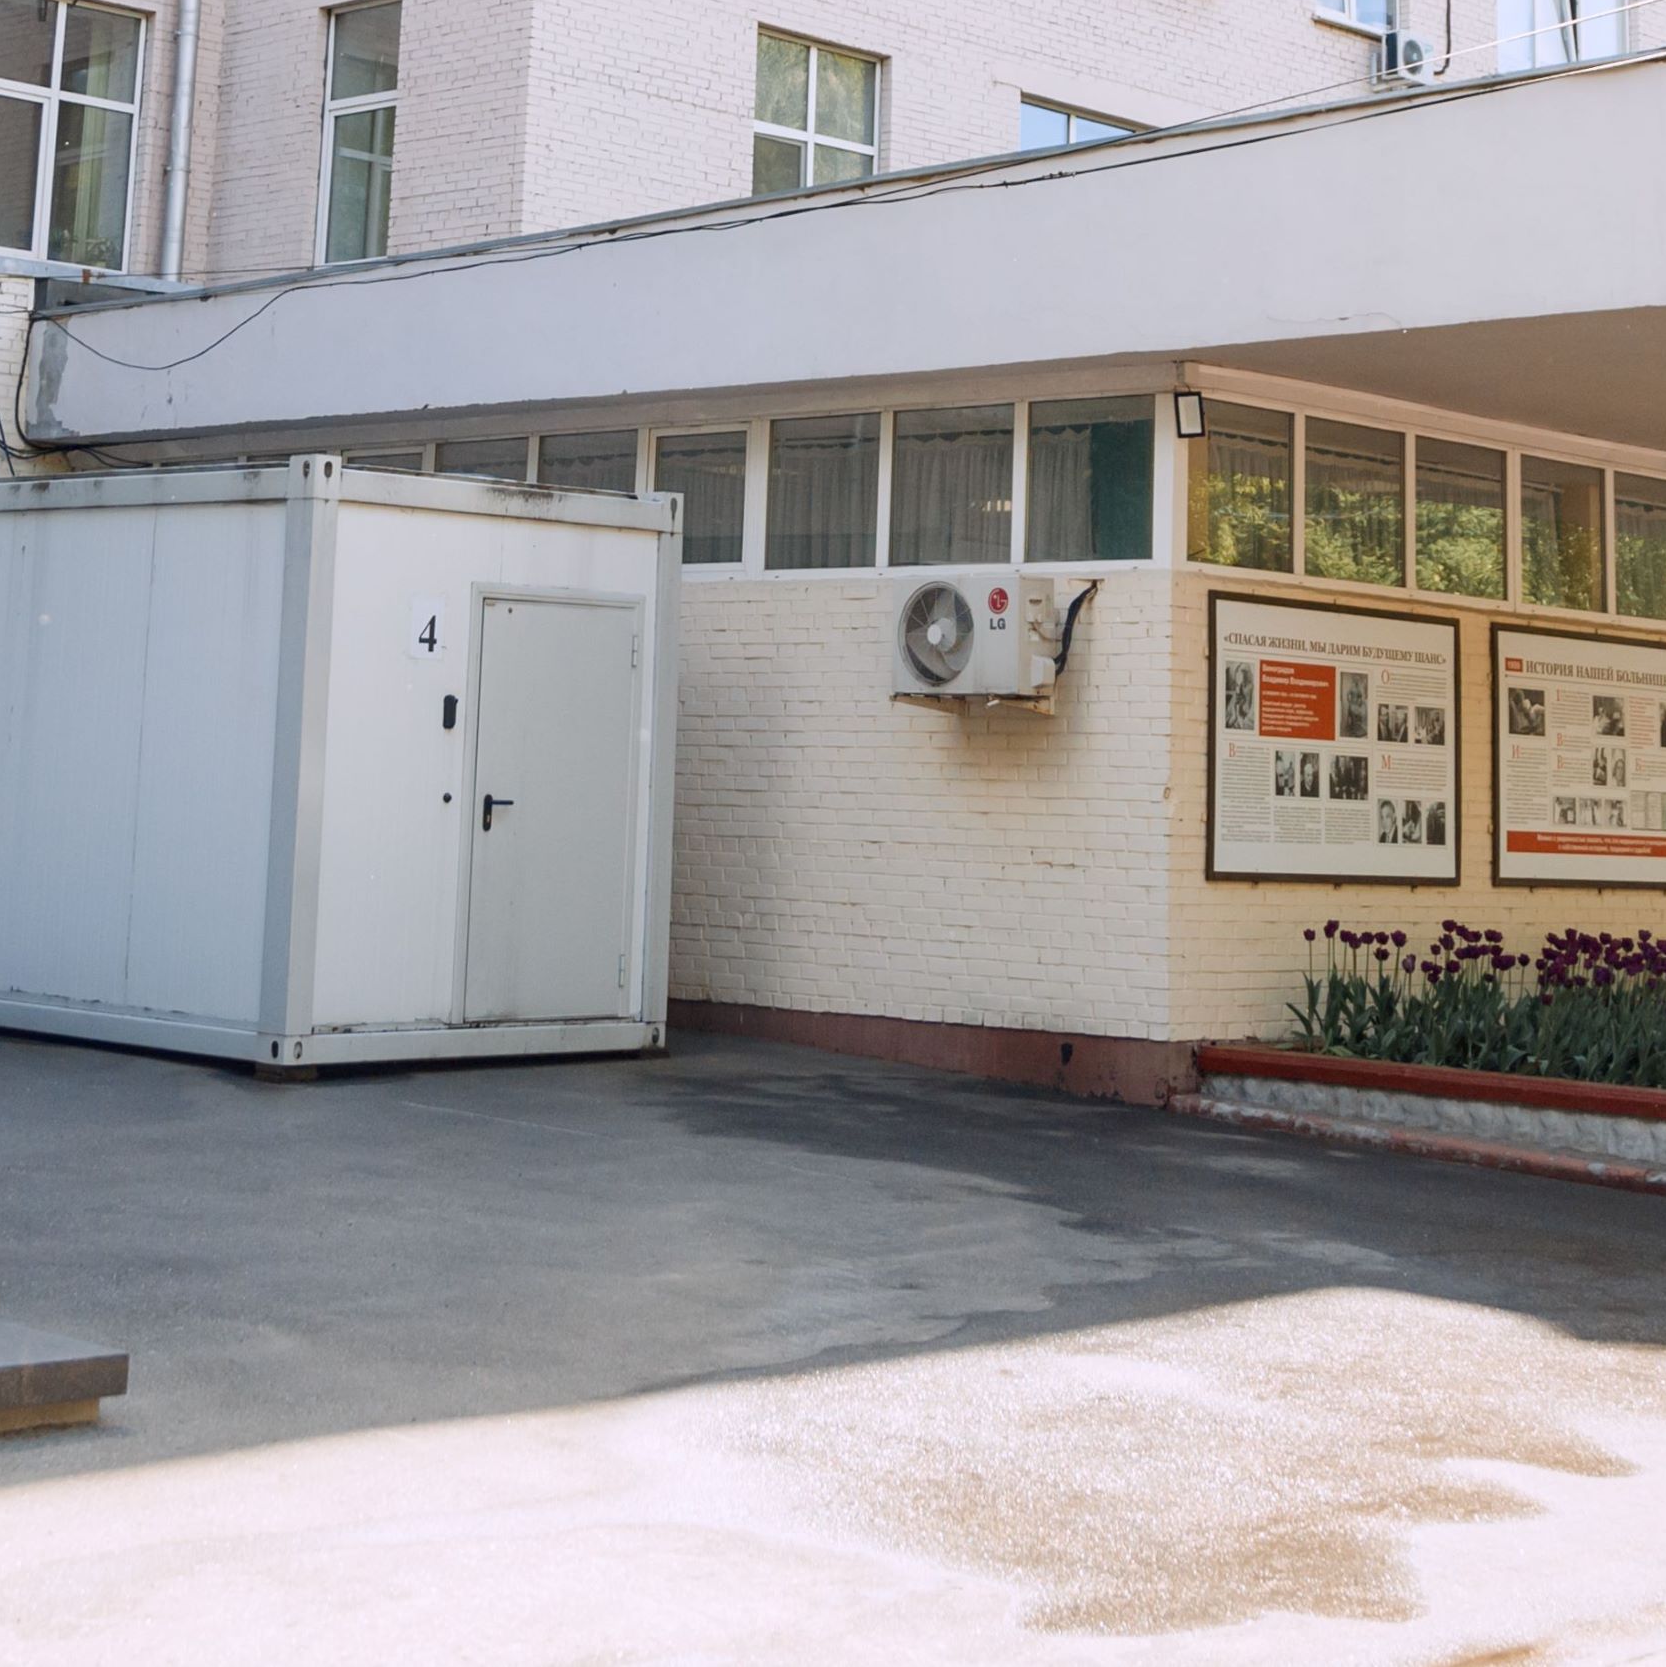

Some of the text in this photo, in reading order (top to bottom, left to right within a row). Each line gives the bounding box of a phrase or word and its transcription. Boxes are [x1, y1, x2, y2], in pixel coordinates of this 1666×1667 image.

[418, 614, 437, 653] 4
[989, 617, 1006, 631] LG
[1224, 632, 1266, 647] «СПАСАЯ
[1309, 640, 1326, 653] МЫ
[1327, 642, 1361, 657] ДАРИМ
[1362, 645, 1413, 662] БУДУЩЕМУ
[1526, 660, 1574, 677] ИСТОРИЯ
[1576, 664, 1614, 681] НАШЕЙ
